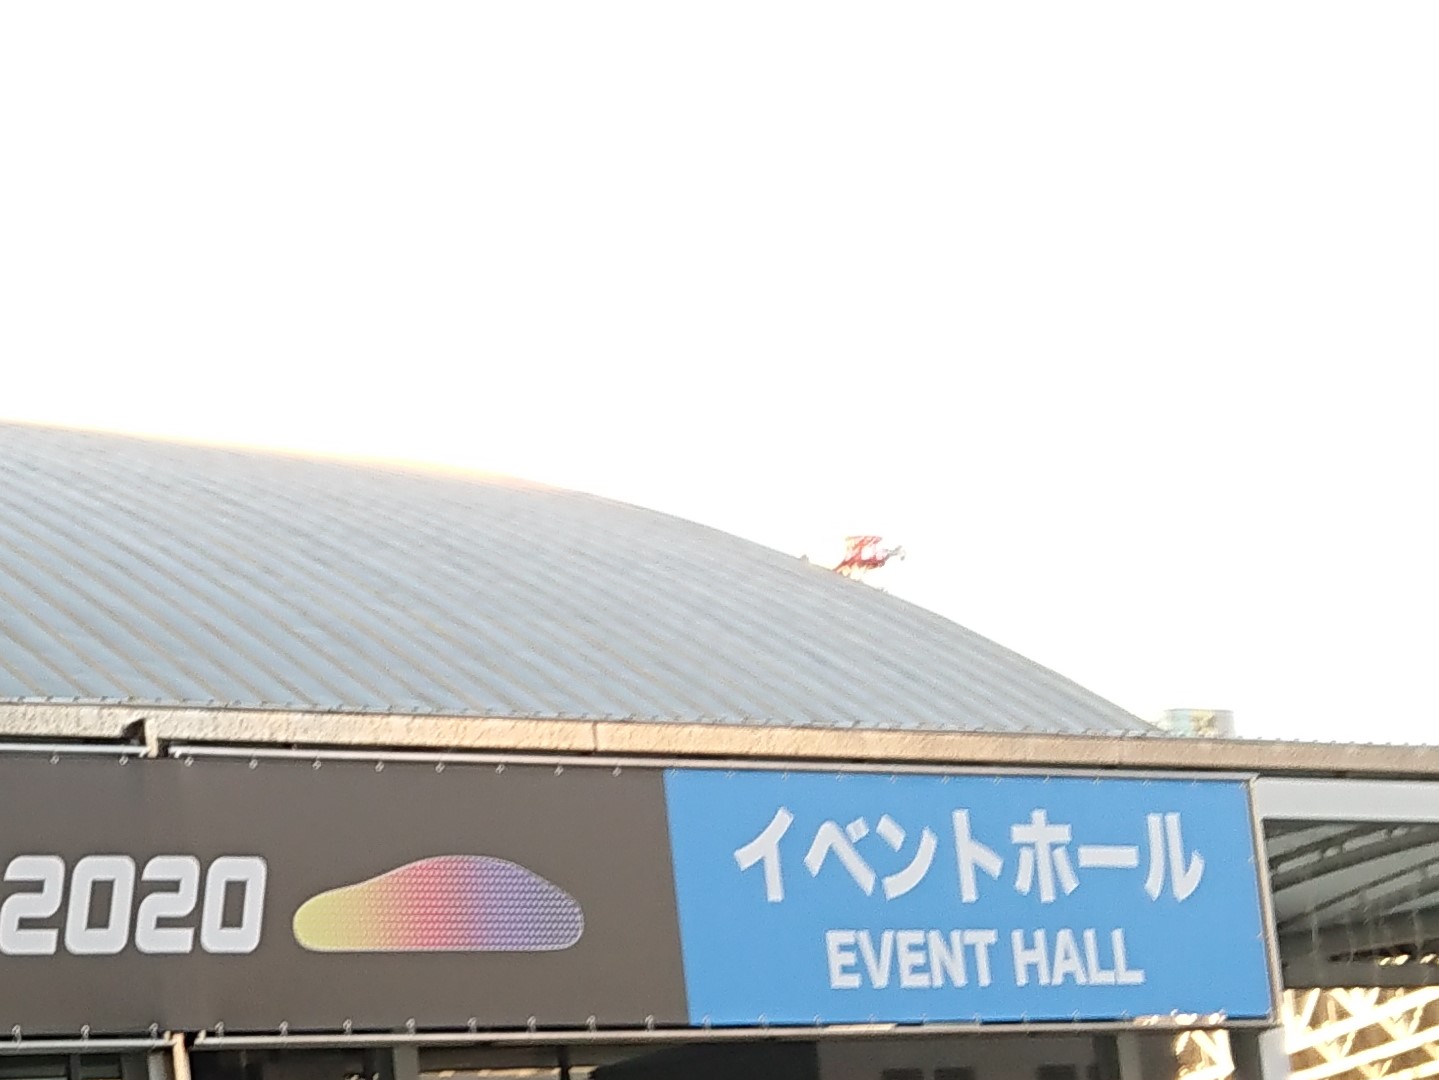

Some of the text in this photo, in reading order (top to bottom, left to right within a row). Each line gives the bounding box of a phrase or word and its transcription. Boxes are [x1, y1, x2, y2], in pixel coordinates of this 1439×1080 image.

[733, 806, 1205, 903] イベントホール
[825, 928, 1146, 989] EVENT HALL
